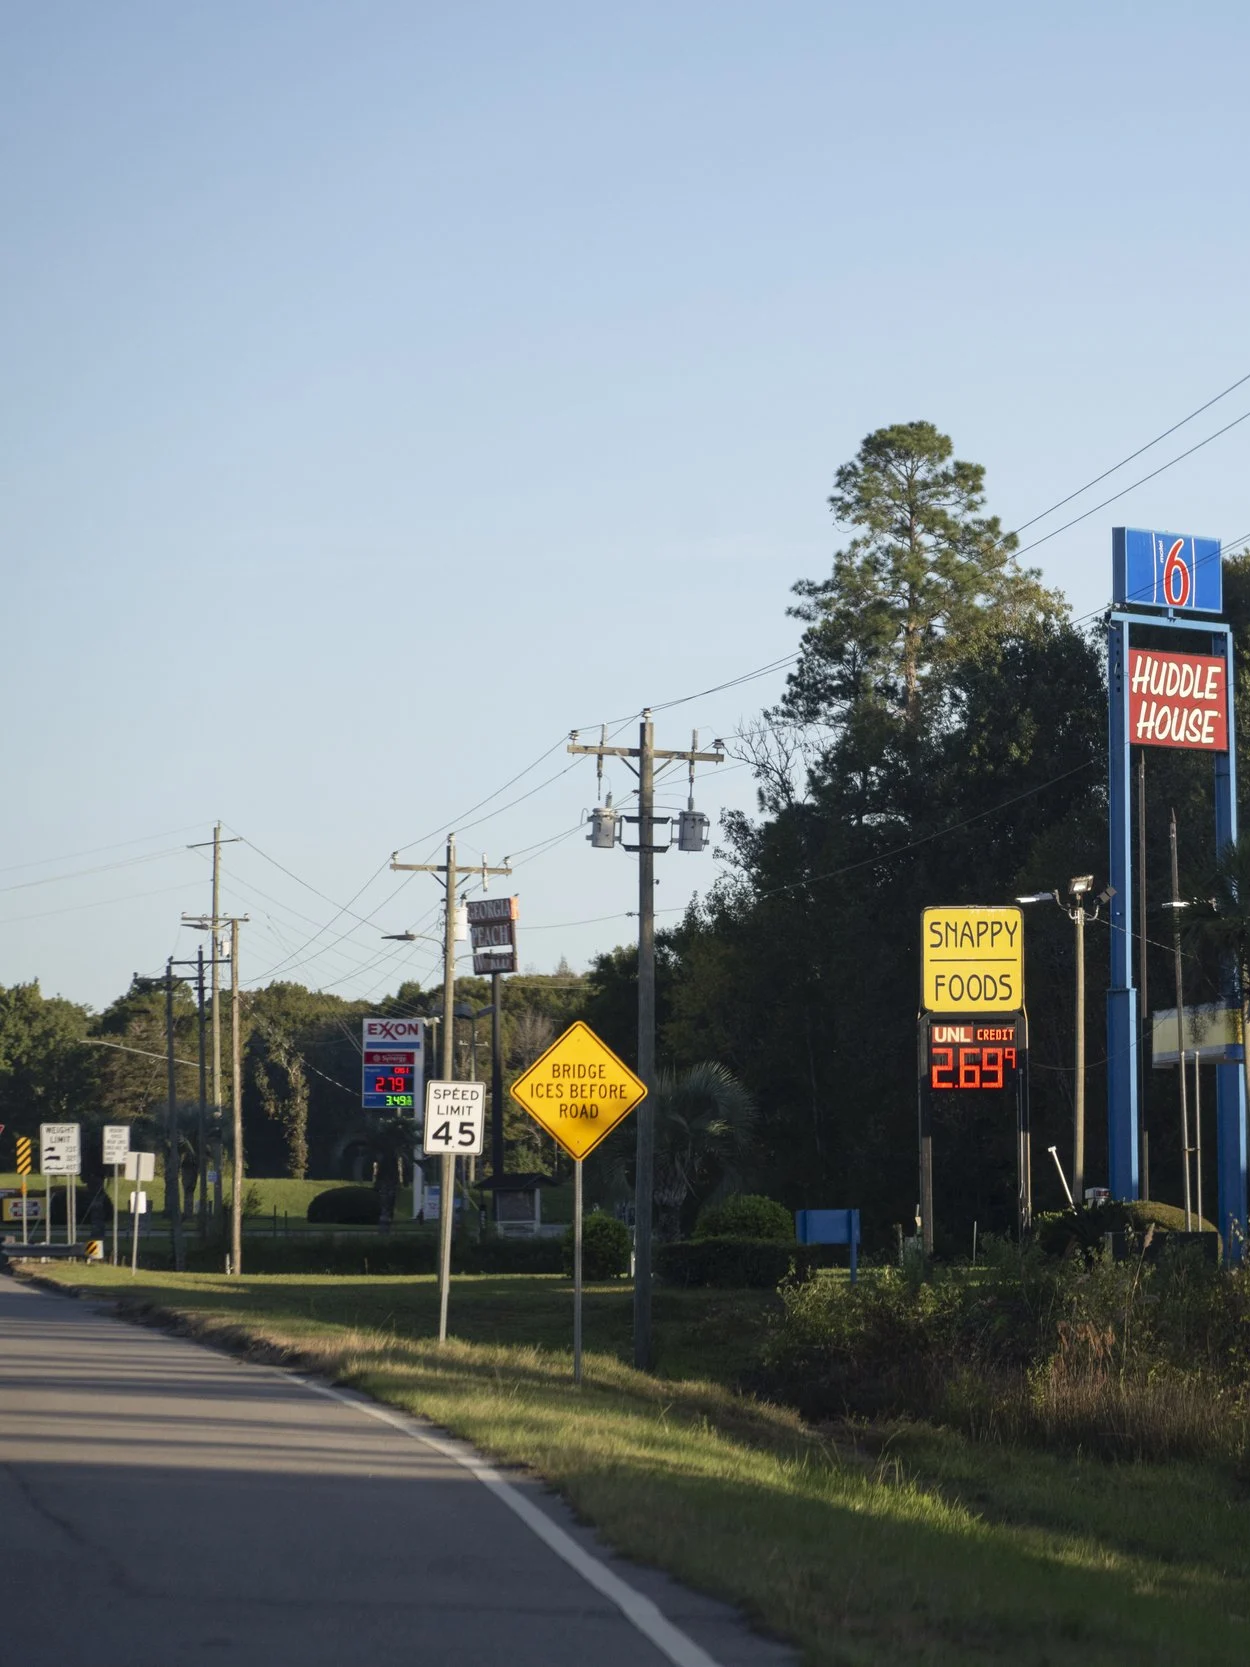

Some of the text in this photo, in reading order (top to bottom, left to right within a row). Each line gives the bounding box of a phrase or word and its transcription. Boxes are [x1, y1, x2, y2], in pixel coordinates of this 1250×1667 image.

[1164, 538, 1190, 606] 6
[1131, 655, 1222, 700] HUDDLE
[1136, 700, 1219, 744] HOUSE
[467, 900, 510, 920] GEORGIA
[471, 924, 509, 947] PEACH
[929, 921, 1018, 948] SNAPPY
[474, 953, 512, 972] WRLD
[935, 974, 1013, 1001] FOODS
[367, 1021, 419, 1041] EXXON
[934, 1027, 971, 1042] UNL
[977, 1029, 1014, 1041] CREDIT
[552, 1063, 606, 1079] BRIDGE
[433, 1089, 479, 1101] SPEED
[530, 1083, 628, 1099] ICES BEFORE
[437, 1104, 473, 1116] LIMIT
[560, 1103, 599, 1119] ROAD
[432, 1121, 476, 1147] 45
